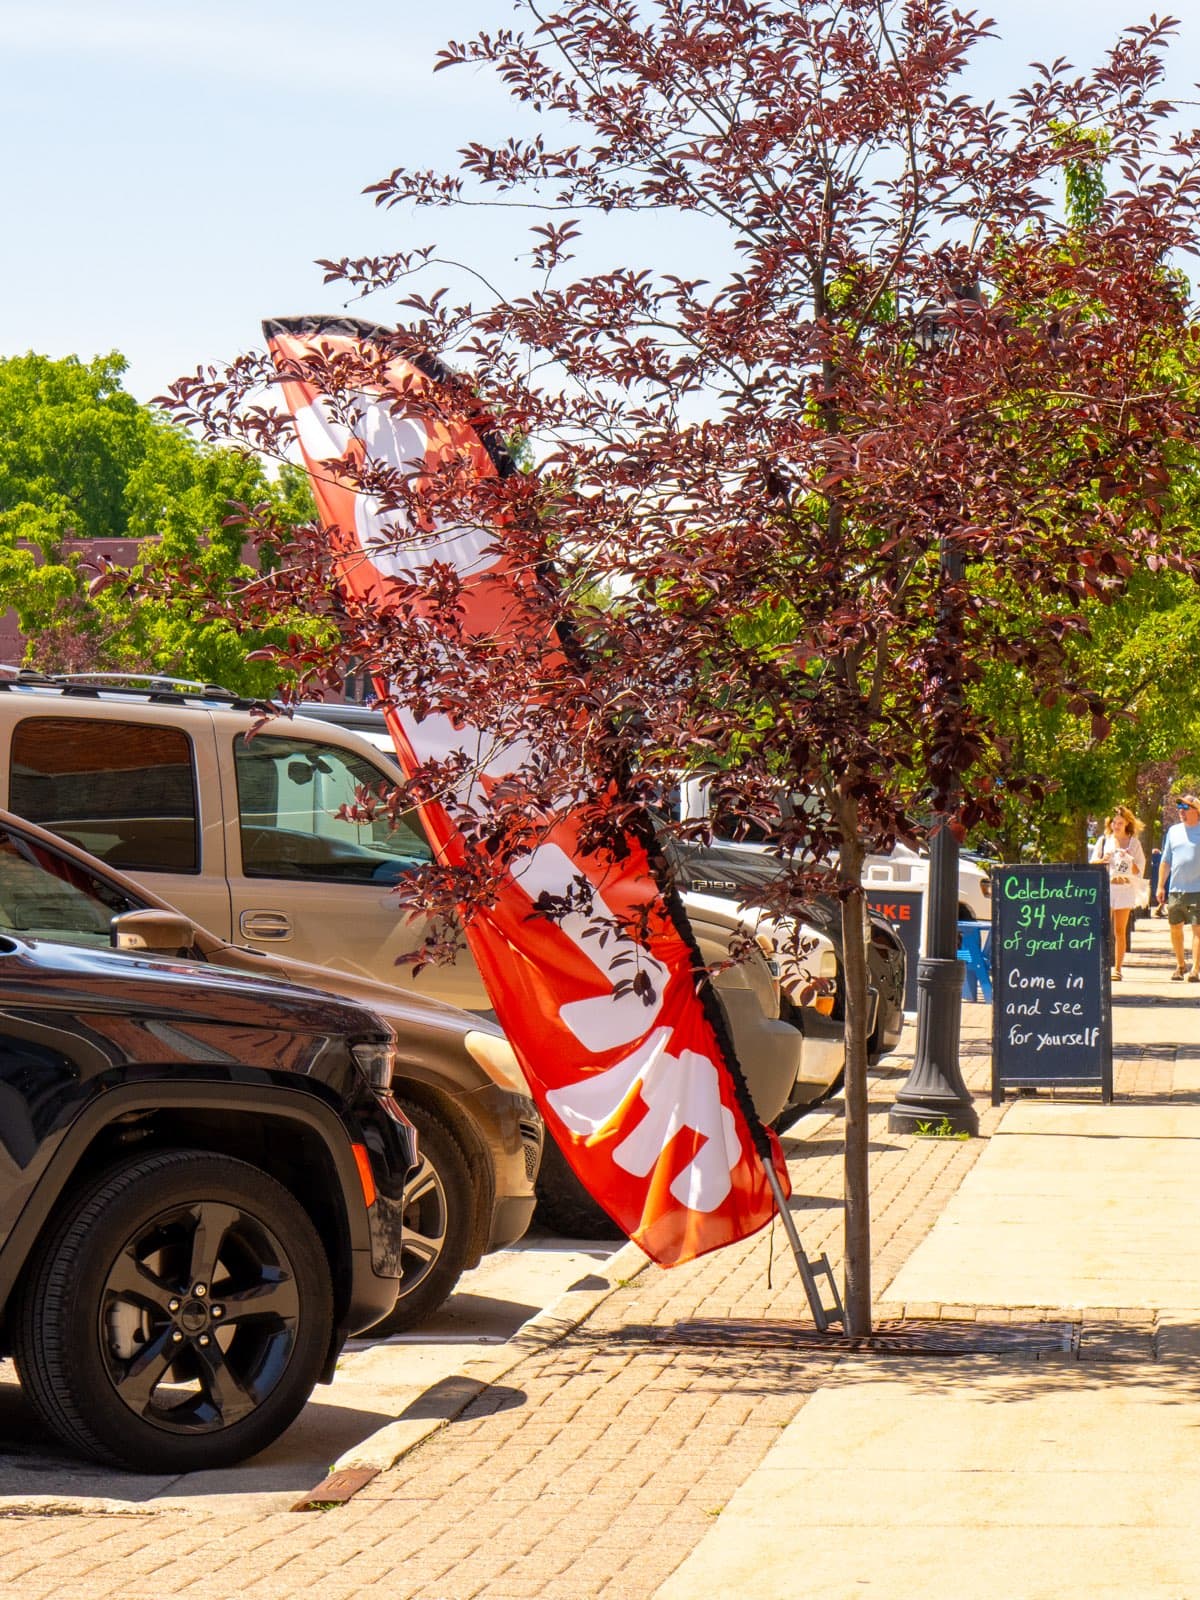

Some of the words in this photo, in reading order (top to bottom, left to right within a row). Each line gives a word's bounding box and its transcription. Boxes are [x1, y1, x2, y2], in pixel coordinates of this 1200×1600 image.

[1004, 876, 1098, 905] Celebrating
[1017, 904, 1046, 929] 34
[1051, 914, 1092, 930] years
[1003, 931, 1023, 951] of
[1026, 933, 1065, 957] great
[1068, 932, 1096, 951] art
[1008, 968, 1056, 989] Come
[1066, 973, 1084, 990] in
[1006, 1000, 1042, 1016] and
[1050, 1002, 1084, 1016] see
[1008, 1024, 1033, 1046] for
[1036, 1027, 1100, 1051] yourself
